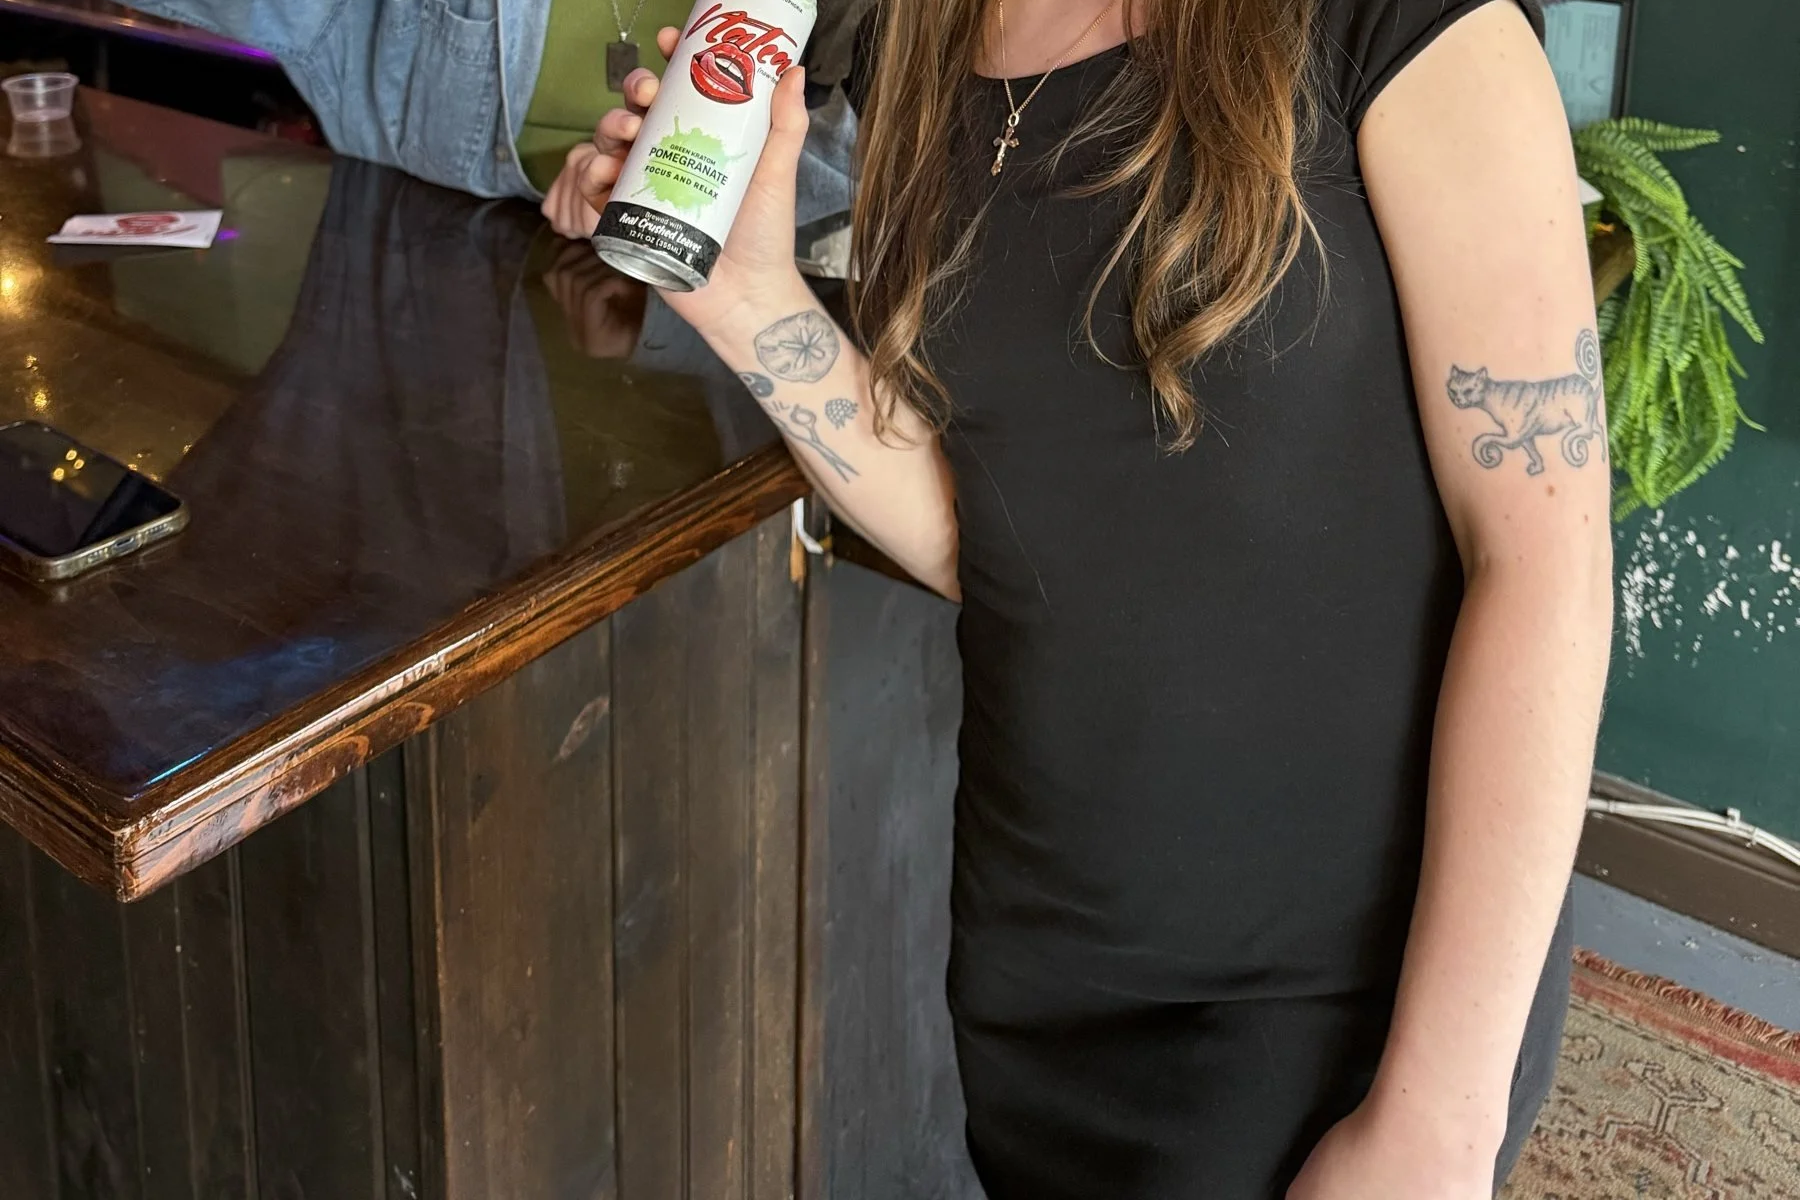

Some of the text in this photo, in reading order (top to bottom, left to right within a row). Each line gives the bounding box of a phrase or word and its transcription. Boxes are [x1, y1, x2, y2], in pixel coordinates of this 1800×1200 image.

[648, 147, 729, 186] POMEGRANATE
[670, 143, 717, 166] GREEN KRATOM
[645, 165, 719, 200] FOCUS AND RELAX
[619, 212, 702, 254] Real Crushed Leaves
[629, 229, 637, 237] 12
[644, 211, 683, 232] Brewed with
